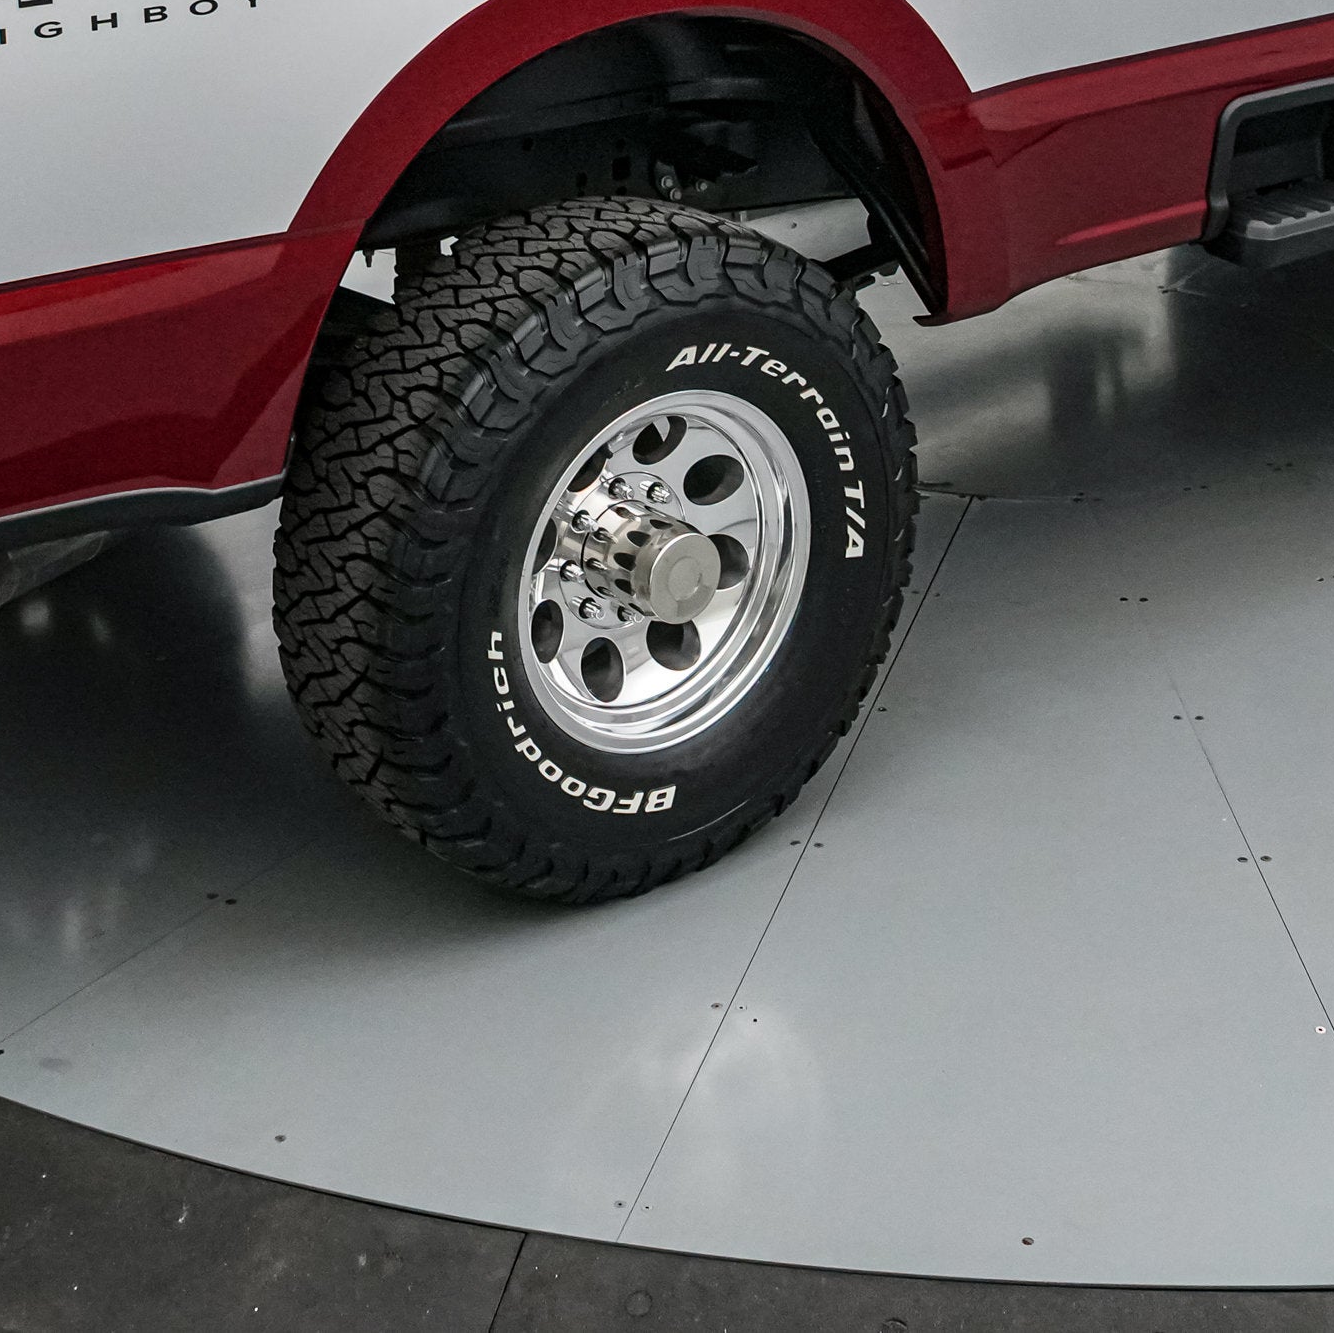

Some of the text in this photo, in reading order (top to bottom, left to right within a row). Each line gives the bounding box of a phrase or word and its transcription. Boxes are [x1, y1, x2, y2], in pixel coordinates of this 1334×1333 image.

[665, 342, 867, 559] All-Terrain T/A
[487, 630, 677, 815] BFGoodrich
